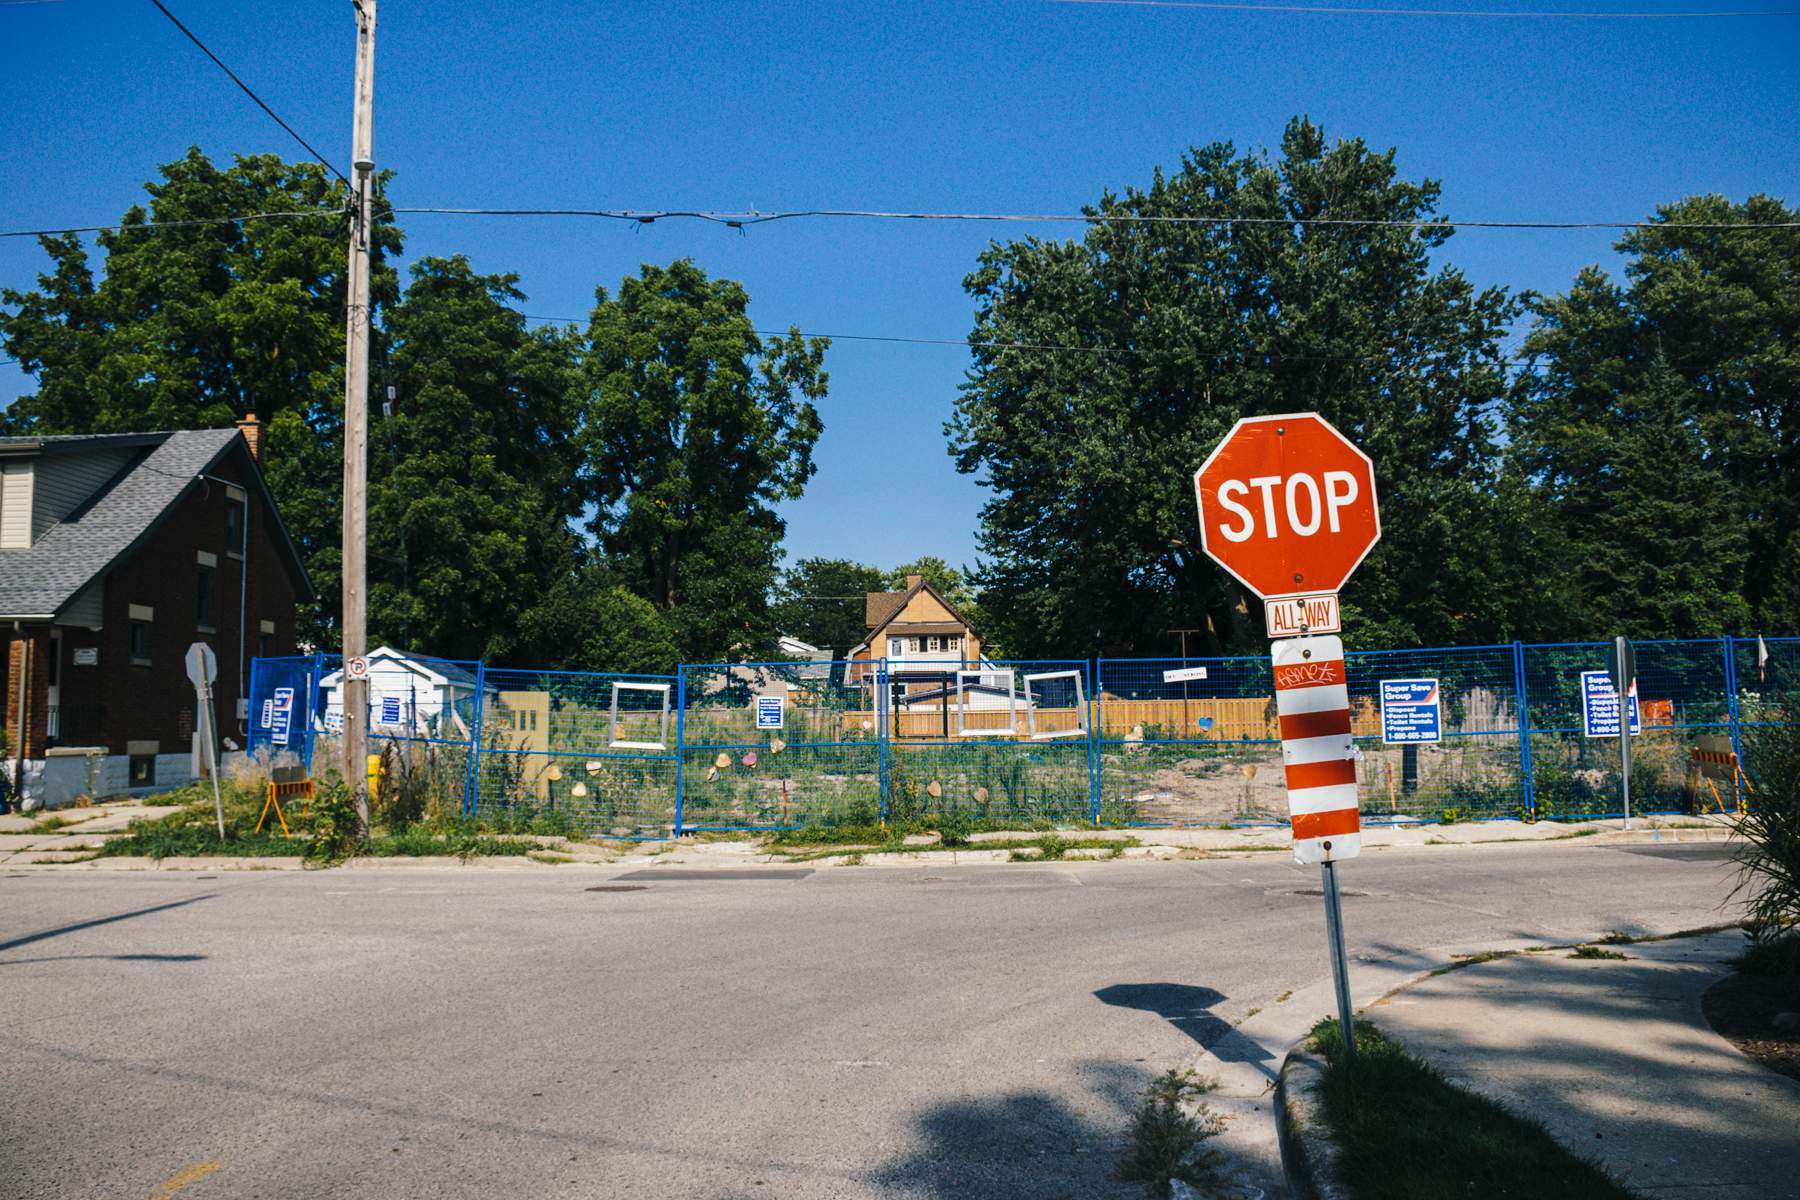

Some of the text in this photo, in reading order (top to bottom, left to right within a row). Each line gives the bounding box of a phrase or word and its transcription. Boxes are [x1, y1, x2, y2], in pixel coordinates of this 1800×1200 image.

[1217, 470, 1359, 543] STOP
[1274, 600, 1331, 631] ALL-WAY
[1385, 685, 1409, 693] Super
